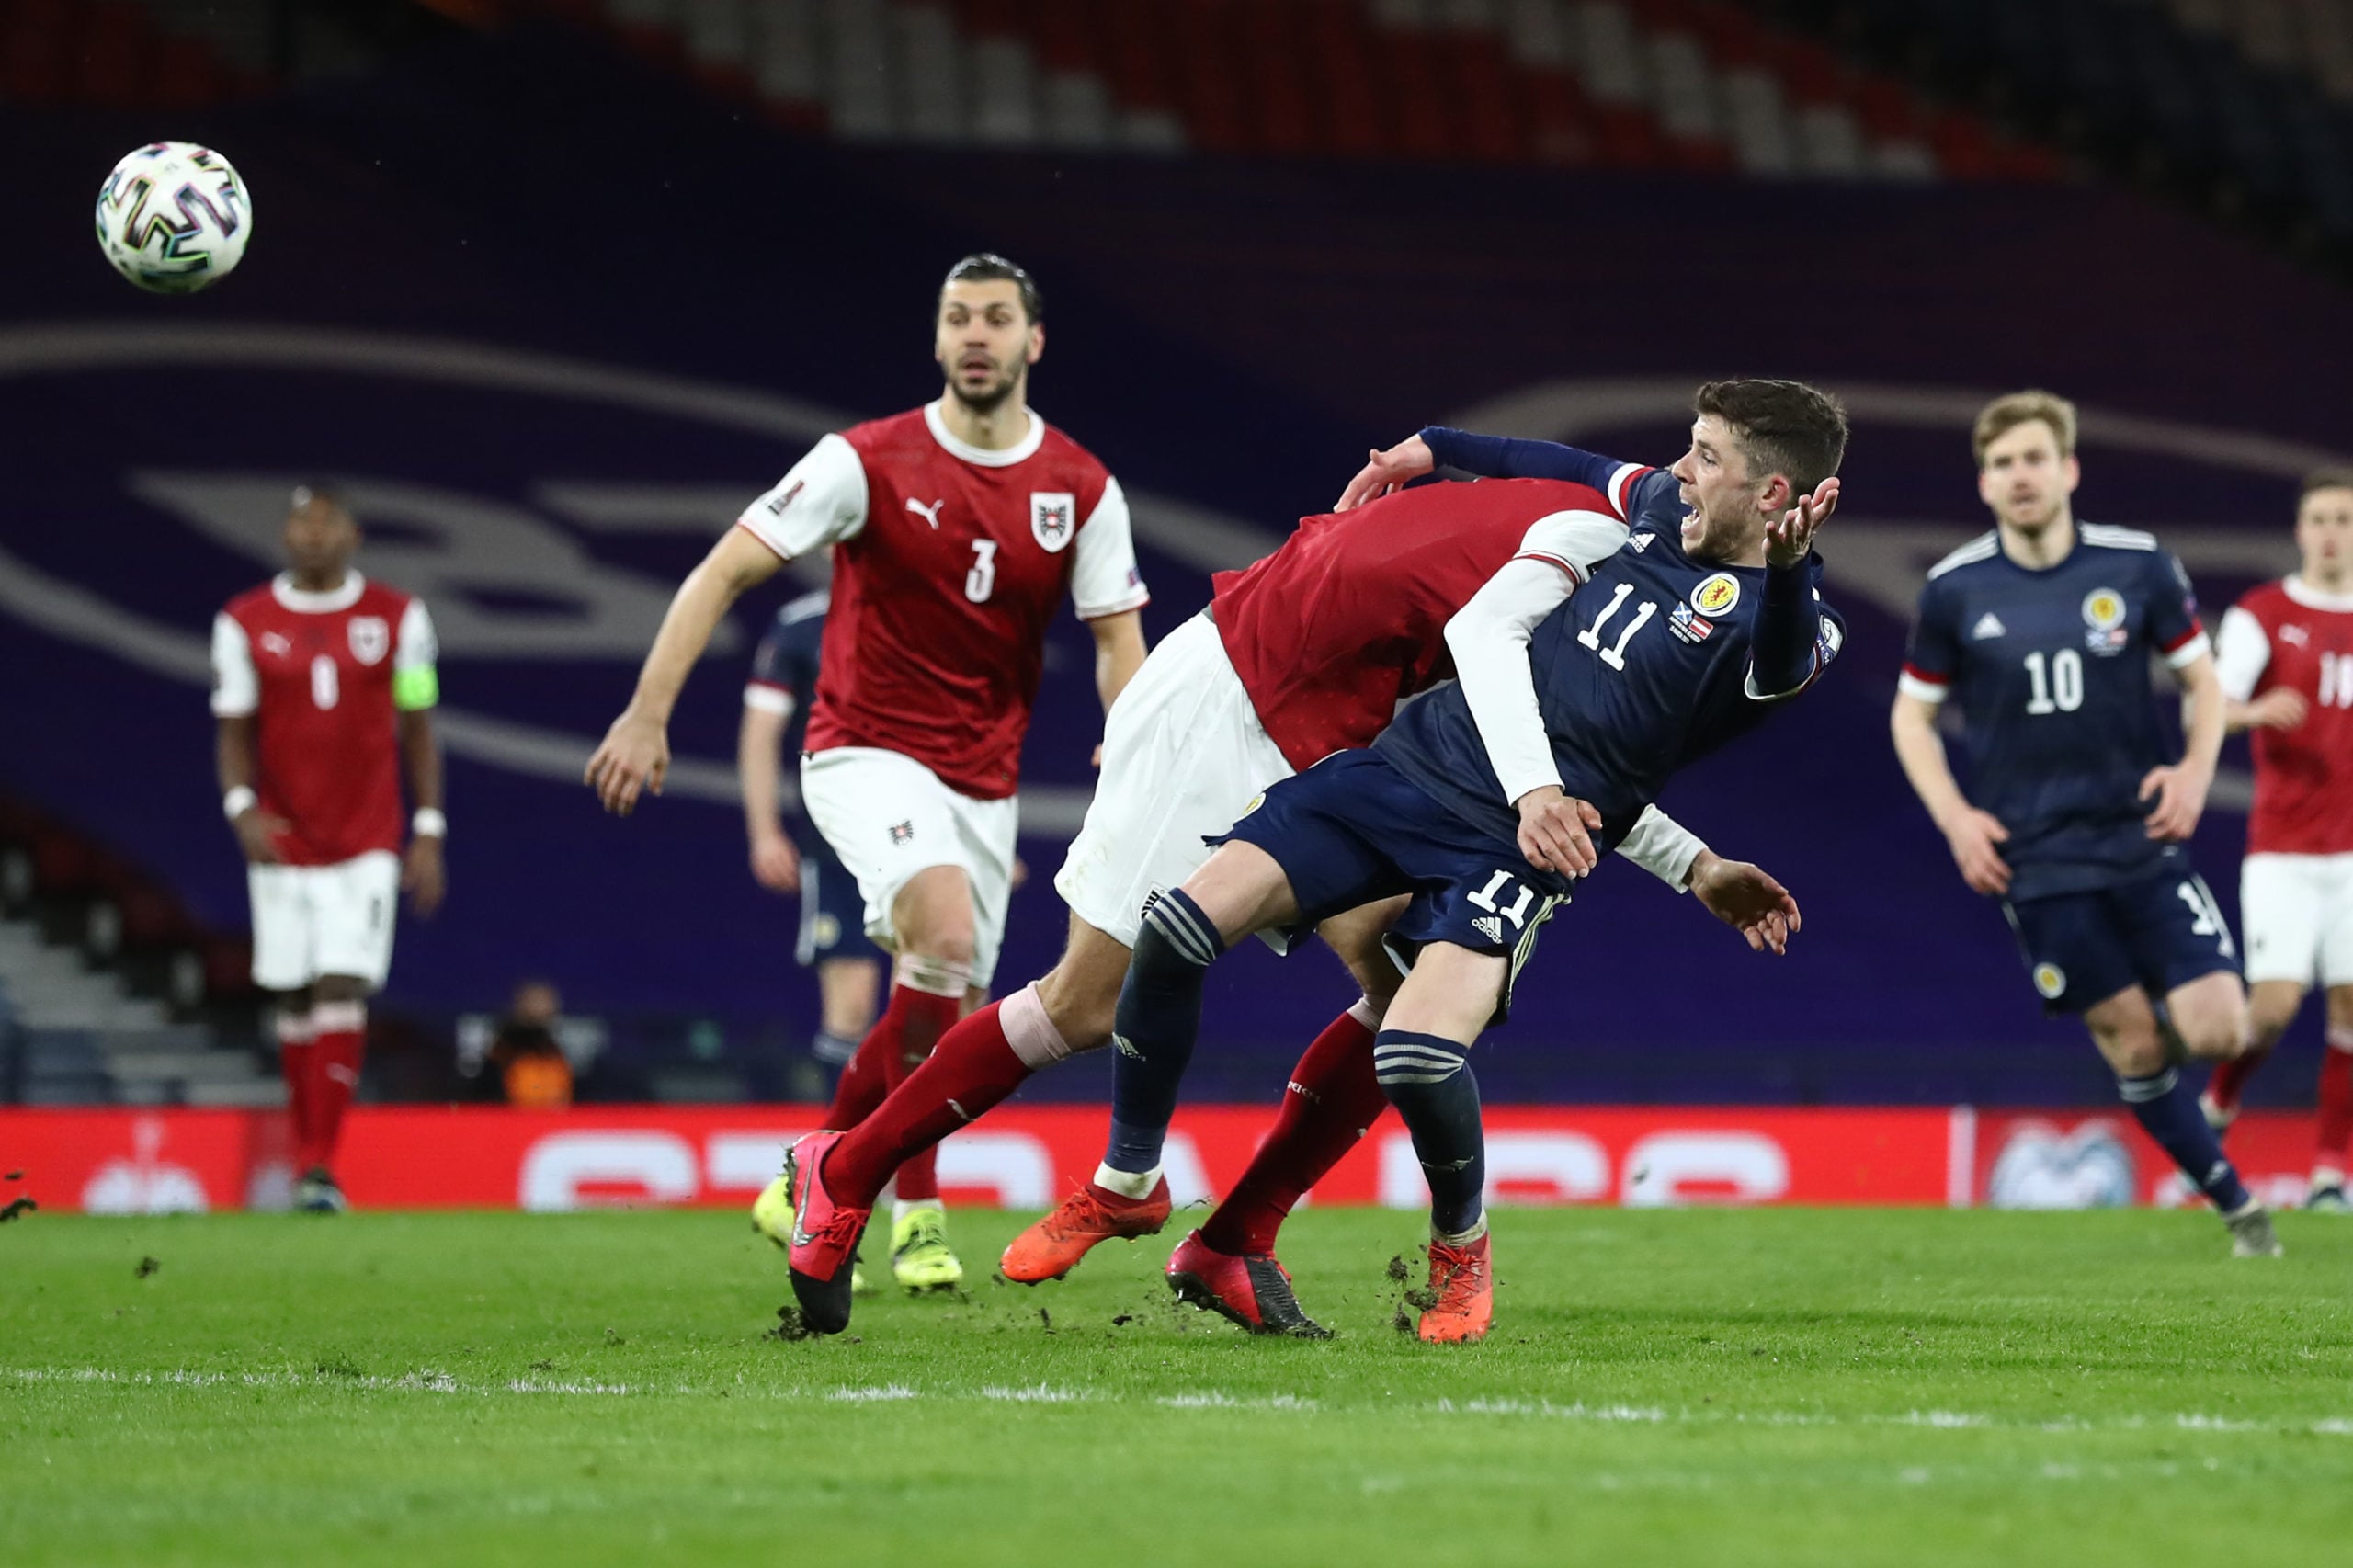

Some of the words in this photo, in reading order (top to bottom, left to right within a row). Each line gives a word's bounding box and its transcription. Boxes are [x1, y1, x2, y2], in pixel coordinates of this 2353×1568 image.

[965, 539, 998, 603] 3
[1577, 583, 1658, 672] 11
[2024, 648, 2084, 715] 10
[1466, 869, 1534, 930] 11
